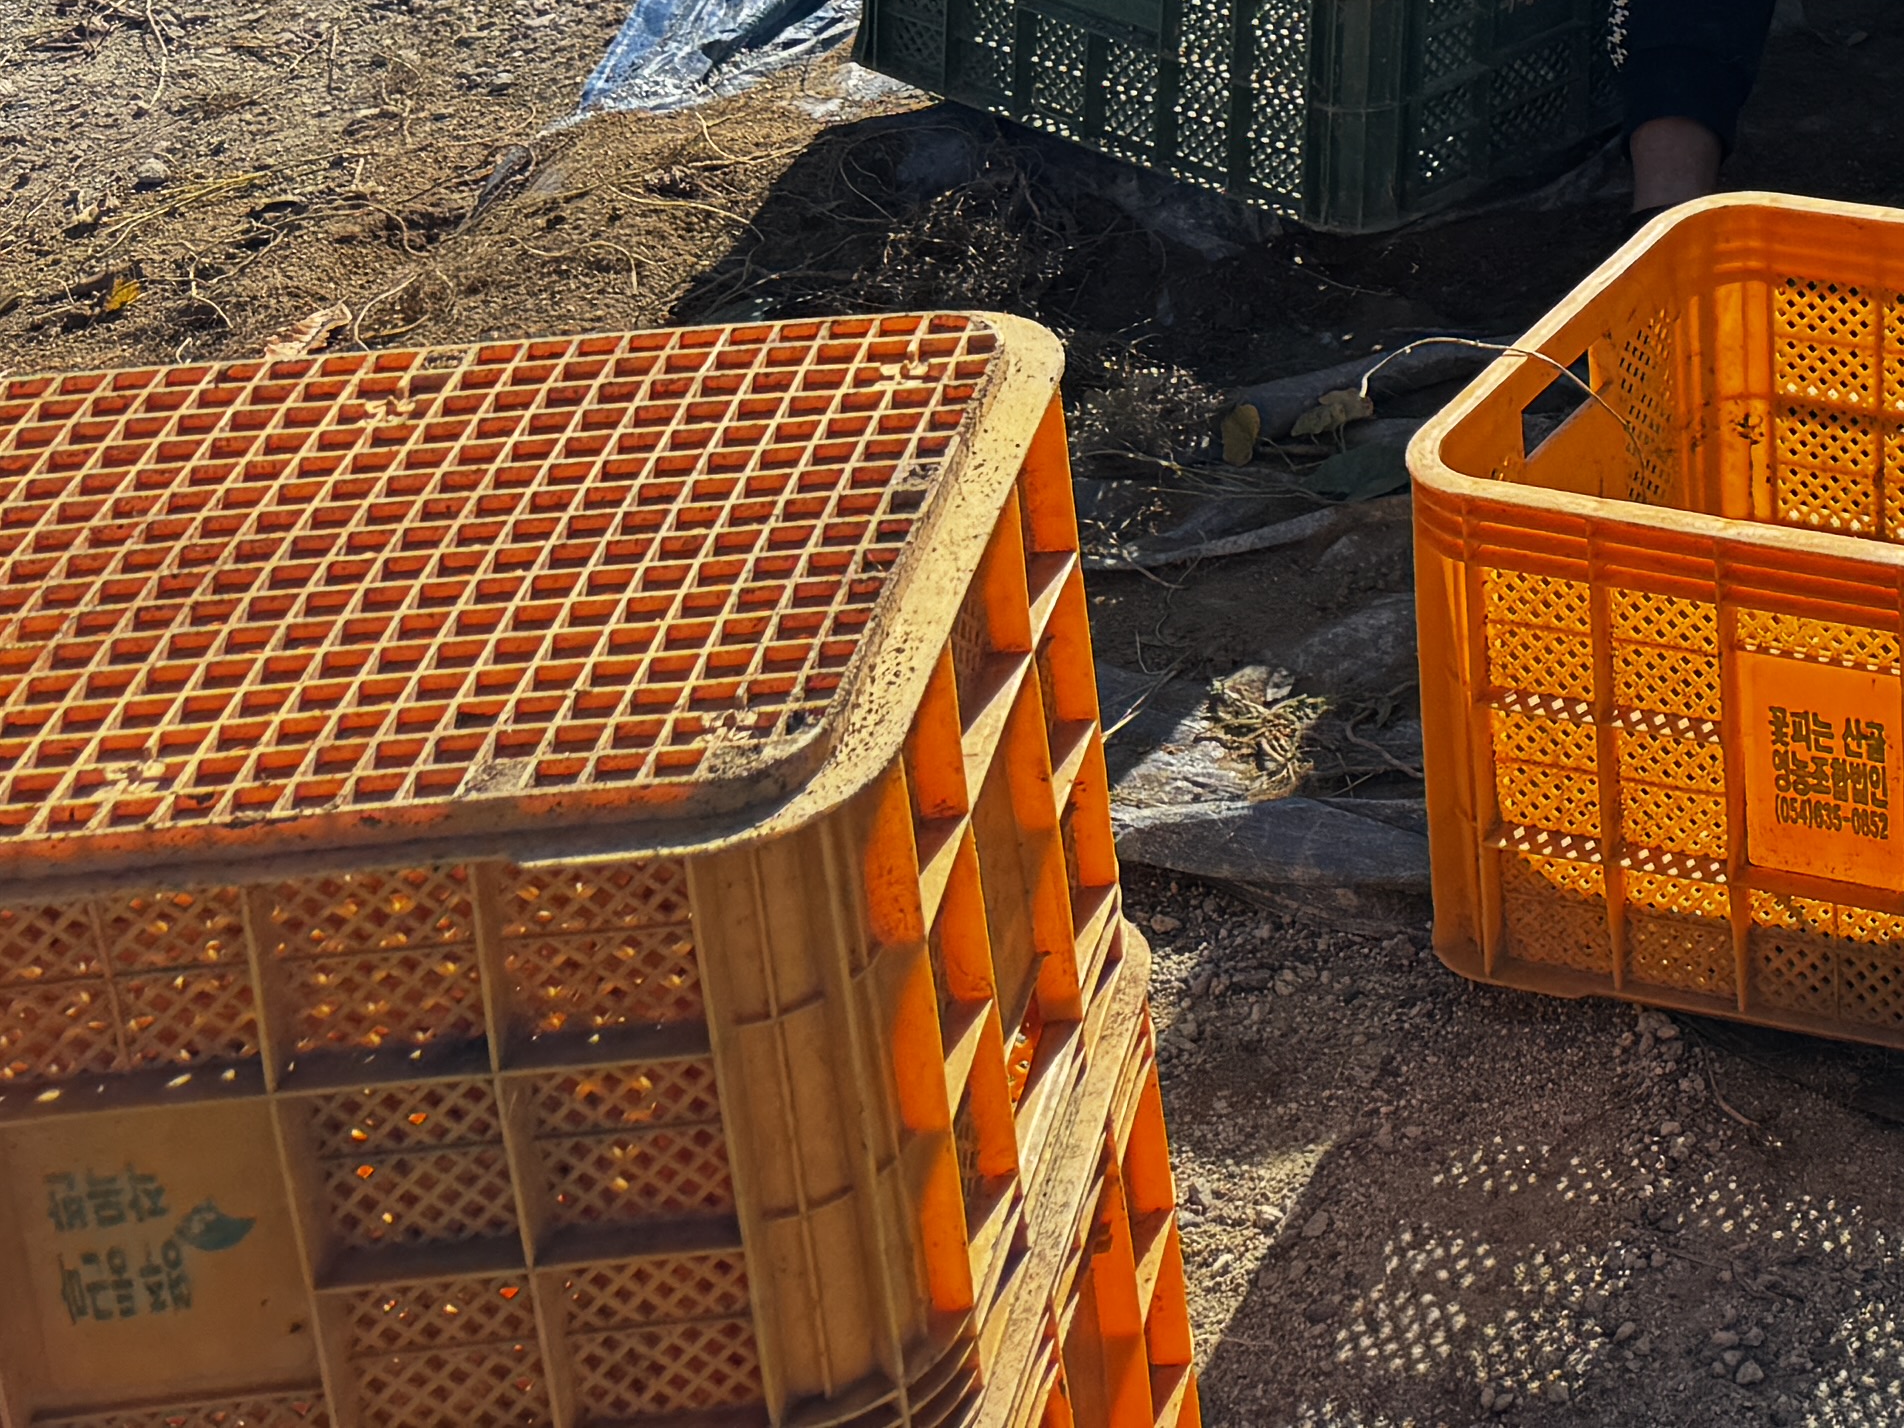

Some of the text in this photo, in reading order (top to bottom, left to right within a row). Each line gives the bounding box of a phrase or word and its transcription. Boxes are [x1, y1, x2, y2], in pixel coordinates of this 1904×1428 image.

[1768, 705, 1887, 764] 꽃피는 산골
[1772, 748, 1889, 811] 영농조합법인
[1775, 793, 1889, 841] (054)635-0852
